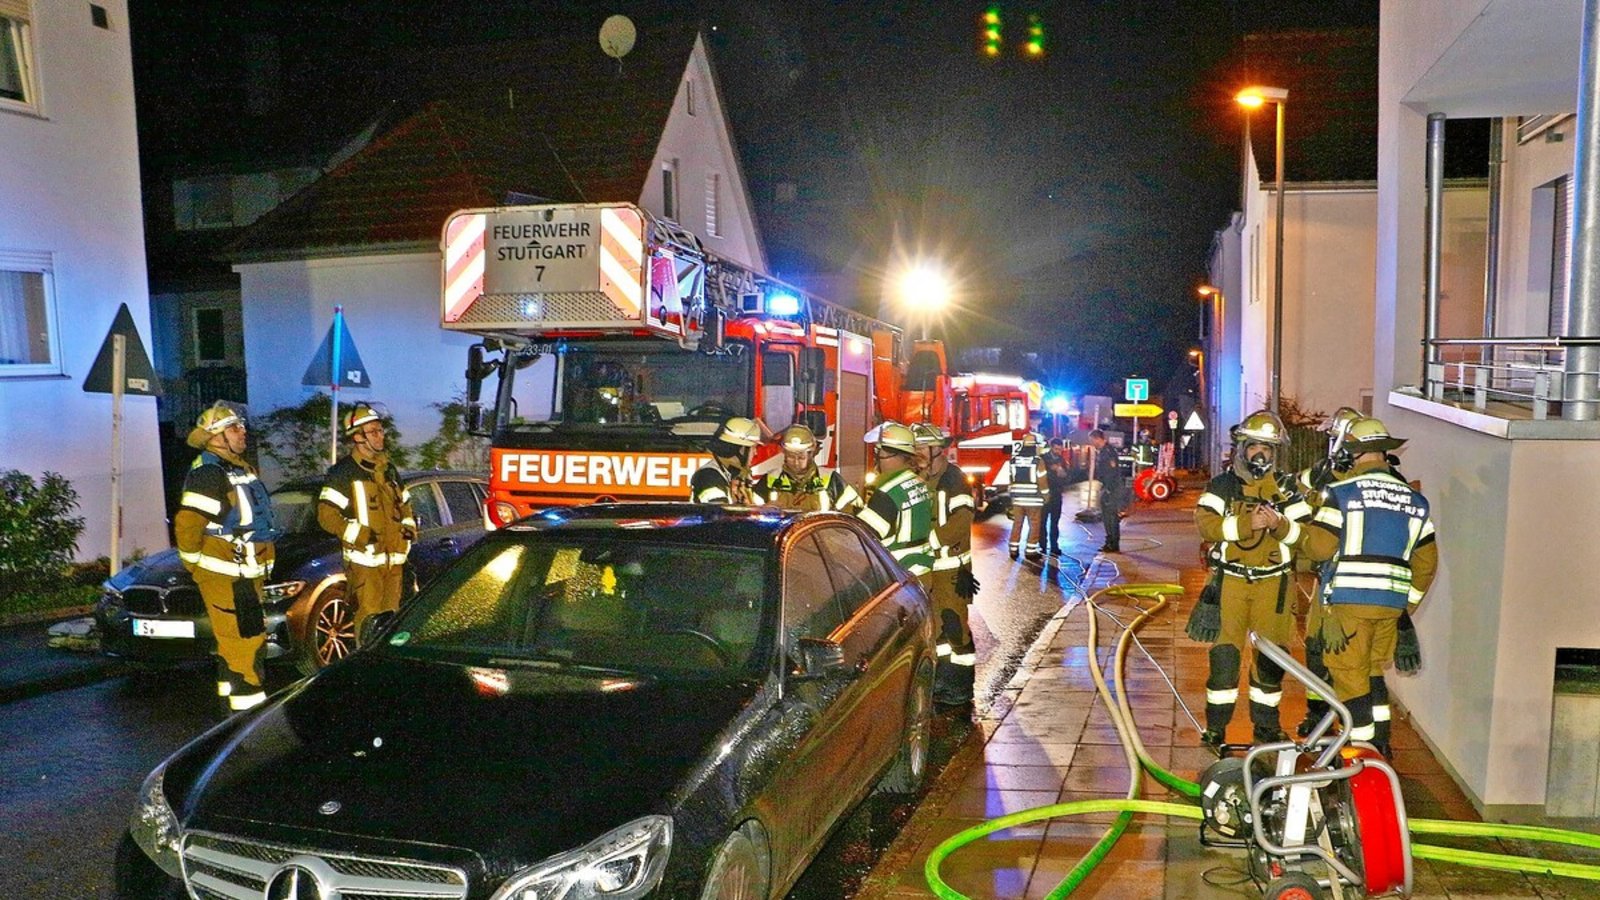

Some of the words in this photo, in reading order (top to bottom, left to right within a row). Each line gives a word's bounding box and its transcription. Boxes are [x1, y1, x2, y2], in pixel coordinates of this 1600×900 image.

[493, 222, 591, 240] FEUERWEHR
[497, 240, 586, 261] STUTTGART
[535, 265, 546, 282] 7
[737, 344, 745, 356] 7
[1361, 489, 1412, 504] STUTTGART
